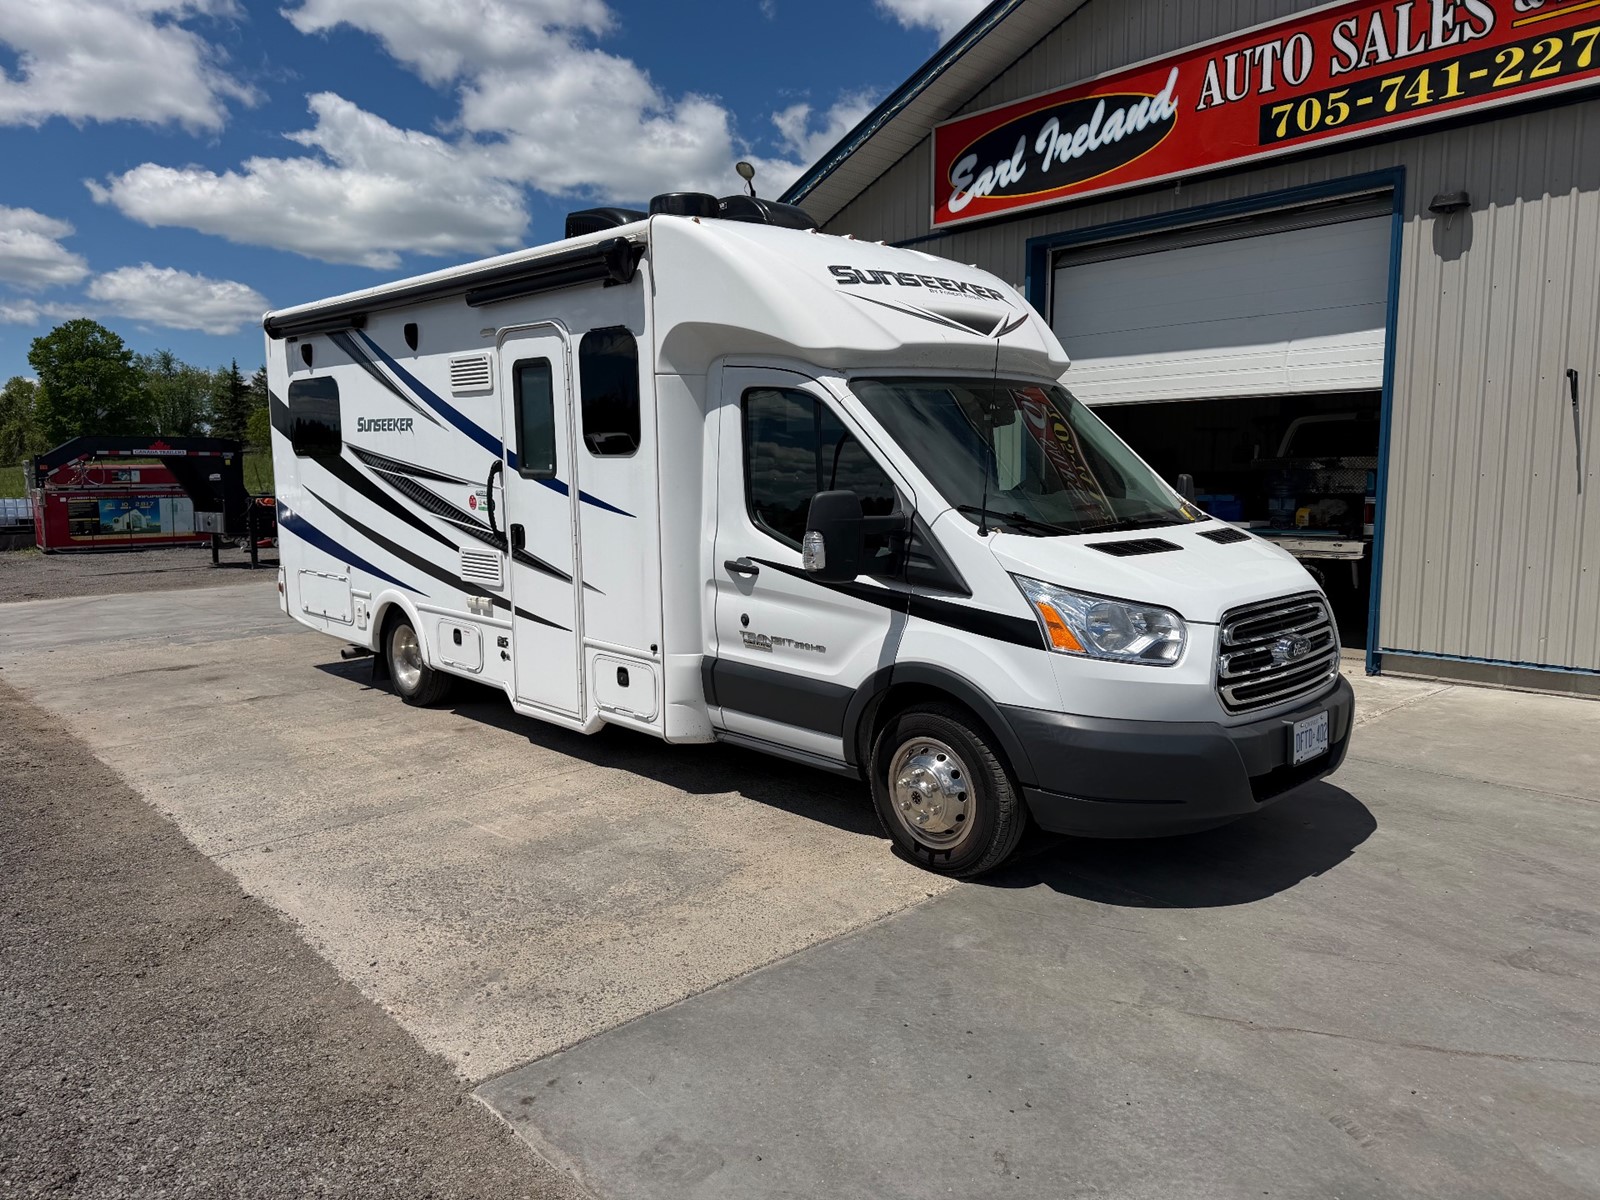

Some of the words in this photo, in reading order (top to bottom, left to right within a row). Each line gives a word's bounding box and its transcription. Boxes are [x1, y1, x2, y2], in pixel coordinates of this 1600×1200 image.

[1196, 33, 1311, 110] AUTO
[1332, 0, 1495, 76] SALES
[1271, 26, 1600, 138] 705-741-227
[948, 135, 1026, 213] Earl
[1035, 67, 1179, 173] Ireland
[1293, 641, 1308, 657] Ford
